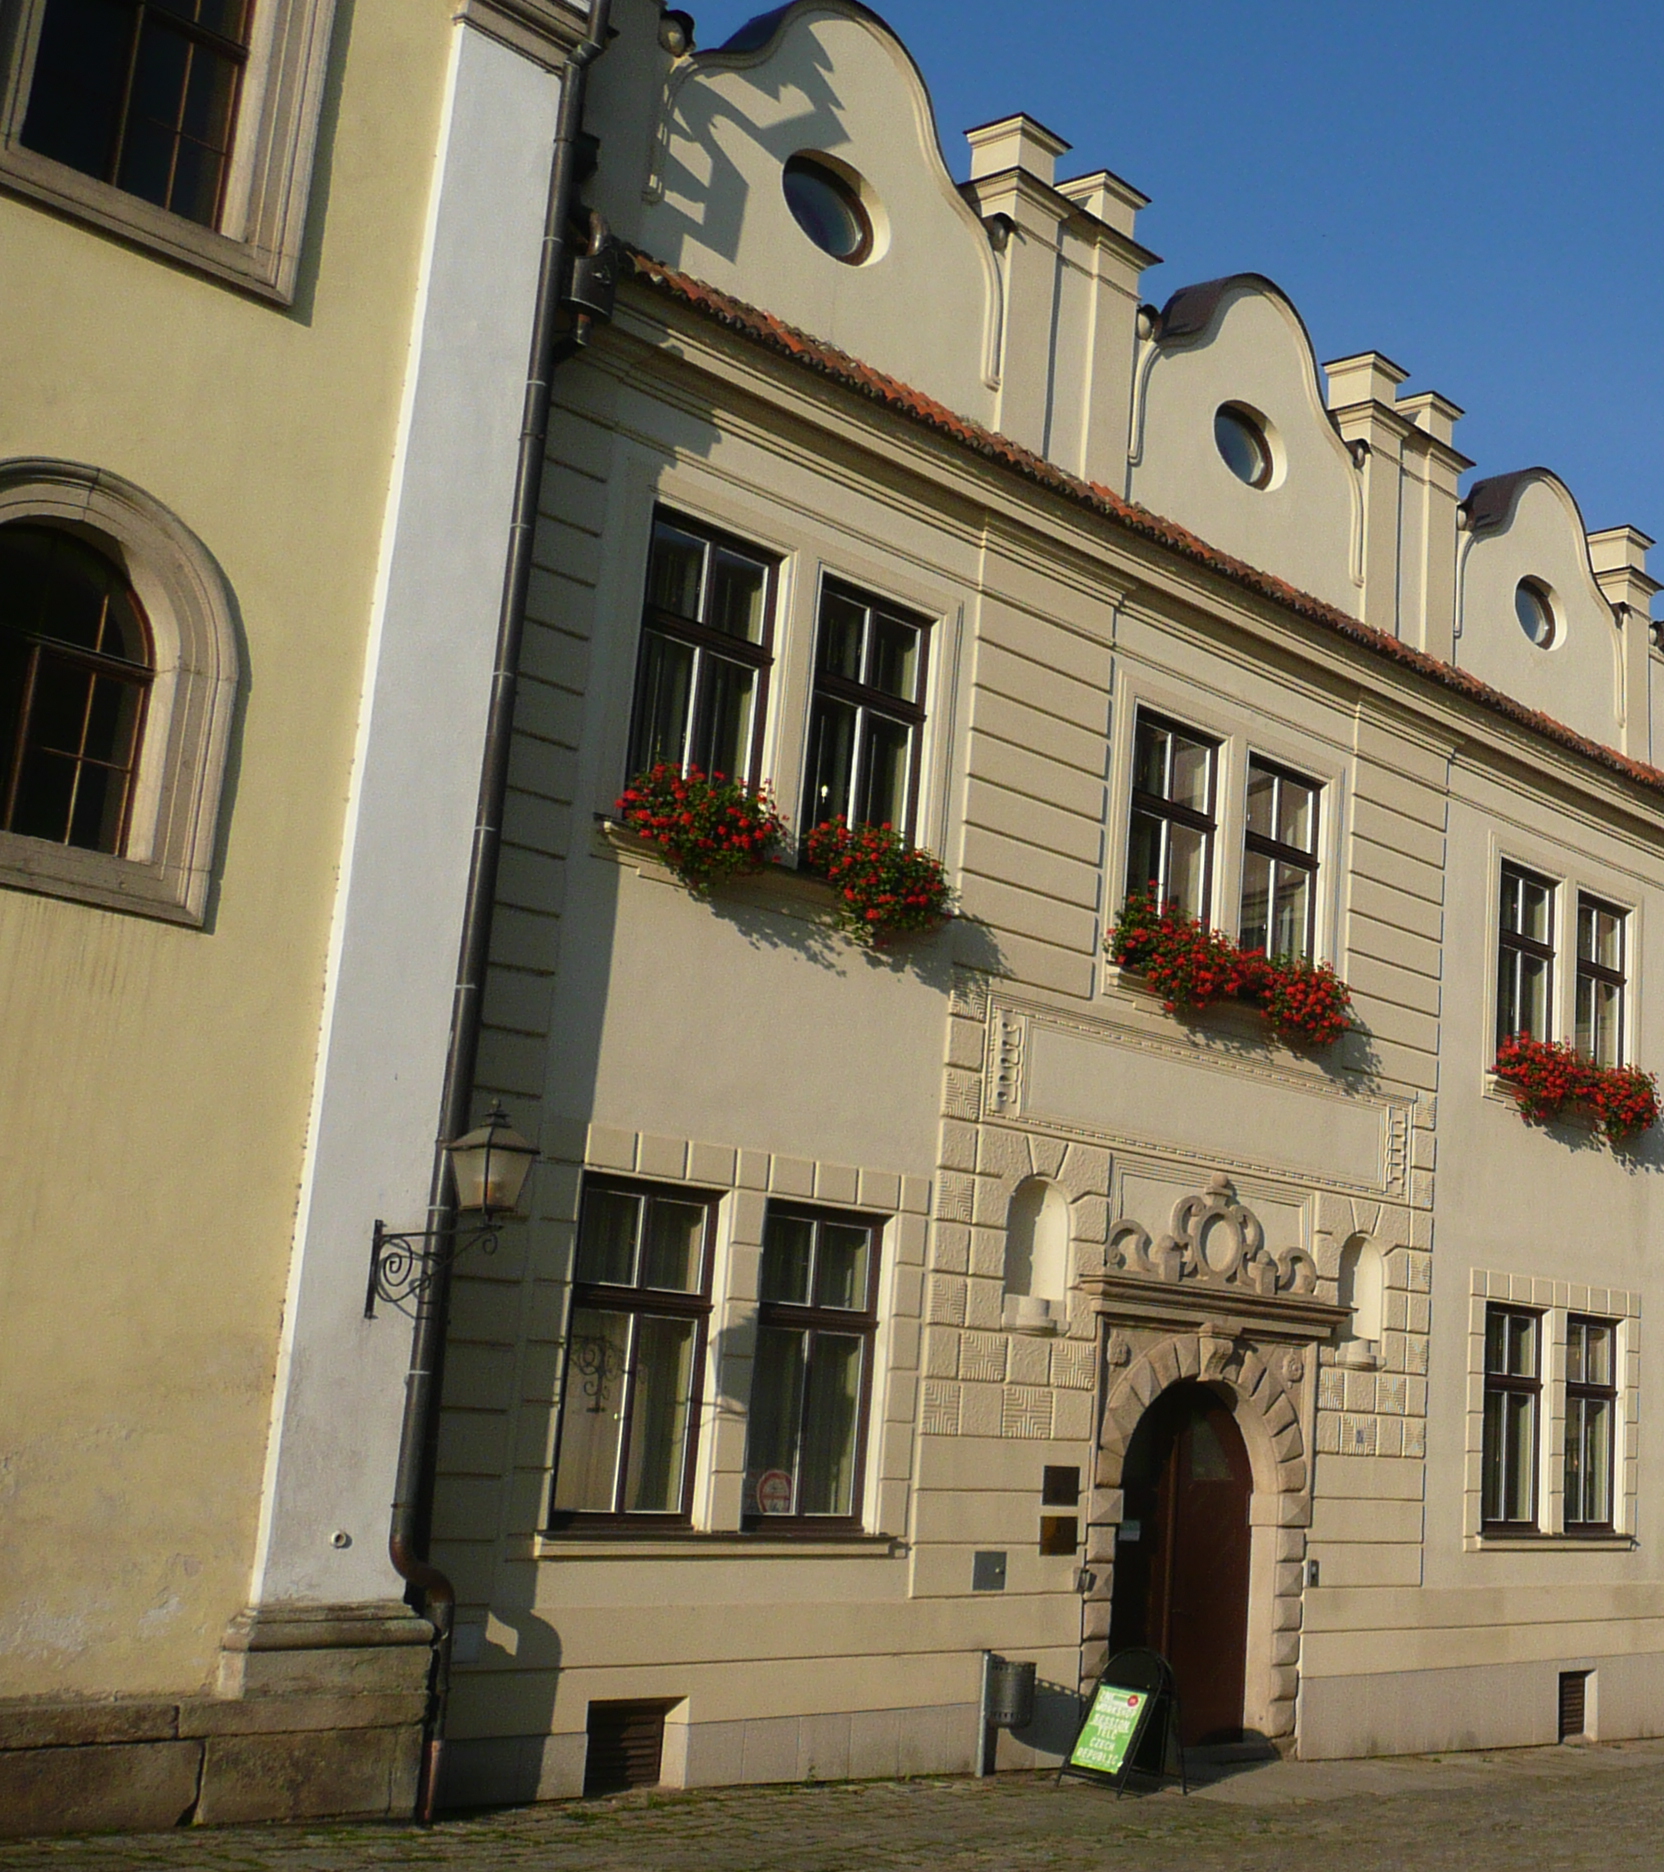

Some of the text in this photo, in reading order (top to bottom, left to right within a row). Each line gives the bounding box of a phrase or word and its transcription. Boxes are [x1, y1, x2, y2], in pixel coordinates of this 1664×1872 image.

[1092, 1713, 1131, 1731] SESSION
[1089, 1737, 1116, 1752] CZECH
[1076, 1746, 1120, 1765] REPUBLIC
